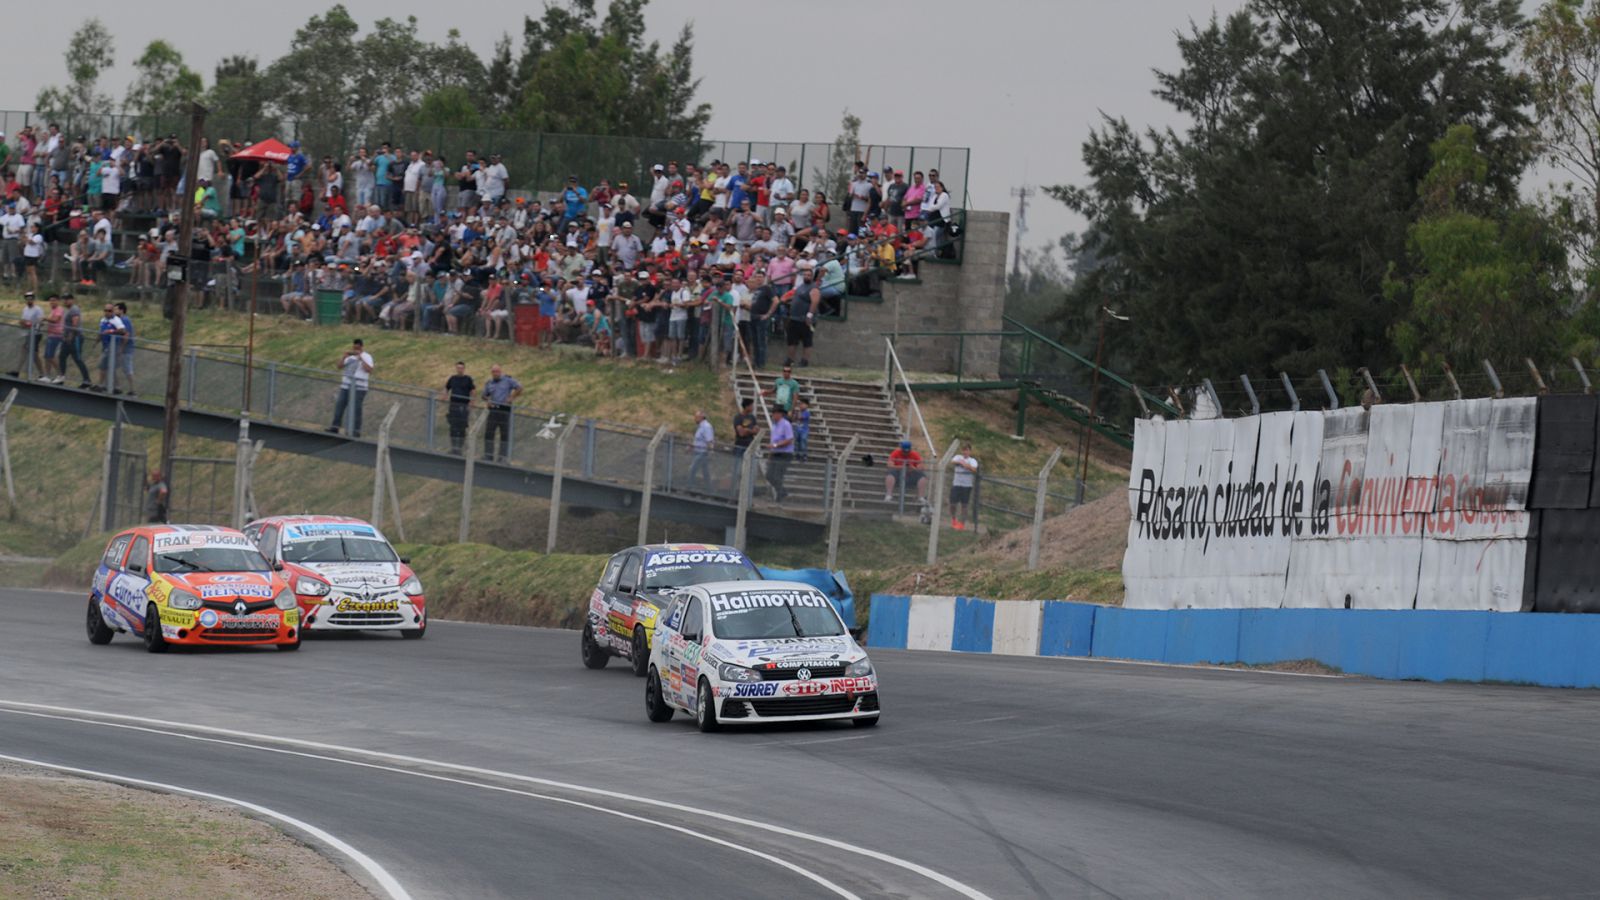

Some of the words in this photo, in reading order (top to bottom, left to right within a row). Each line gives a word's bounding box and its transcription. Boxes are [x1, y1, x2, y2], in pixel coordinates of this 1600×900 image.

[1137, 465, 1210, 555] Rosario,
[1214, 461, 1279, 538] ciudad
[1281, 461, 1304, 536] de
[1311, 461, 1331, 535] la
[1336, 449, 1457, 535] Convivencia
[647, 552, 743, 567] AGROTAX
[202, 587, 273, 598] REINOSO
[336, 599, 400, 613] Ezequiel
[710, 590, 827, 612] Haimovich
[734, 682, 779, 697] SURREY
